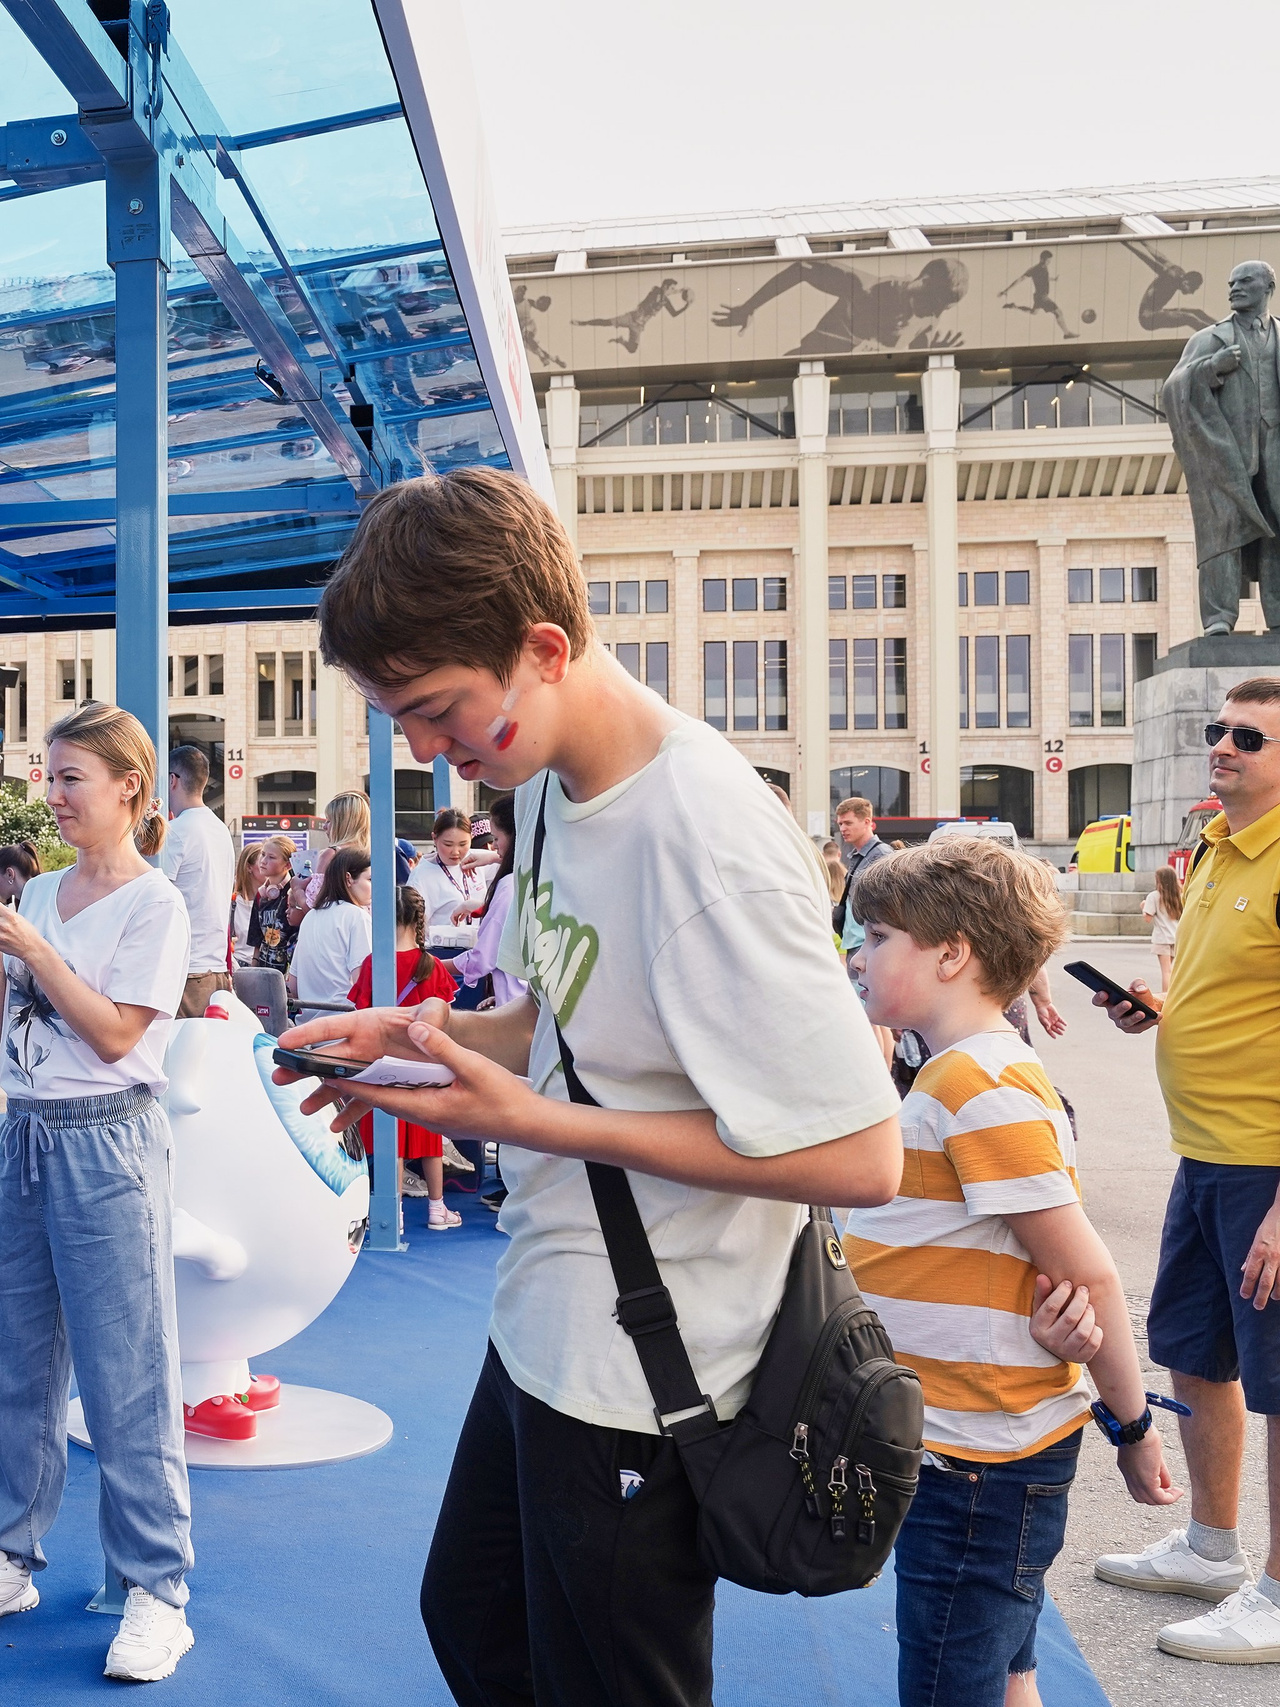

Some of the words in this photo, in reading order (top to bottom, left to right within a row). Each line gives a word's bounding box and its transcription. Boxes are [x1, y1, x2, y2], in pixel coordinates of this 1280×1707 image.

[919, 741, 930, 754] 1
[1044, 740, 1064, 753] 12
[28, 753, 43, 765] 11
[228, 749, 244, 761] 11
[1048, 759, 1060, 771] C
[31, 770, 40, 781] C
[231, 766, 241, 778] C
